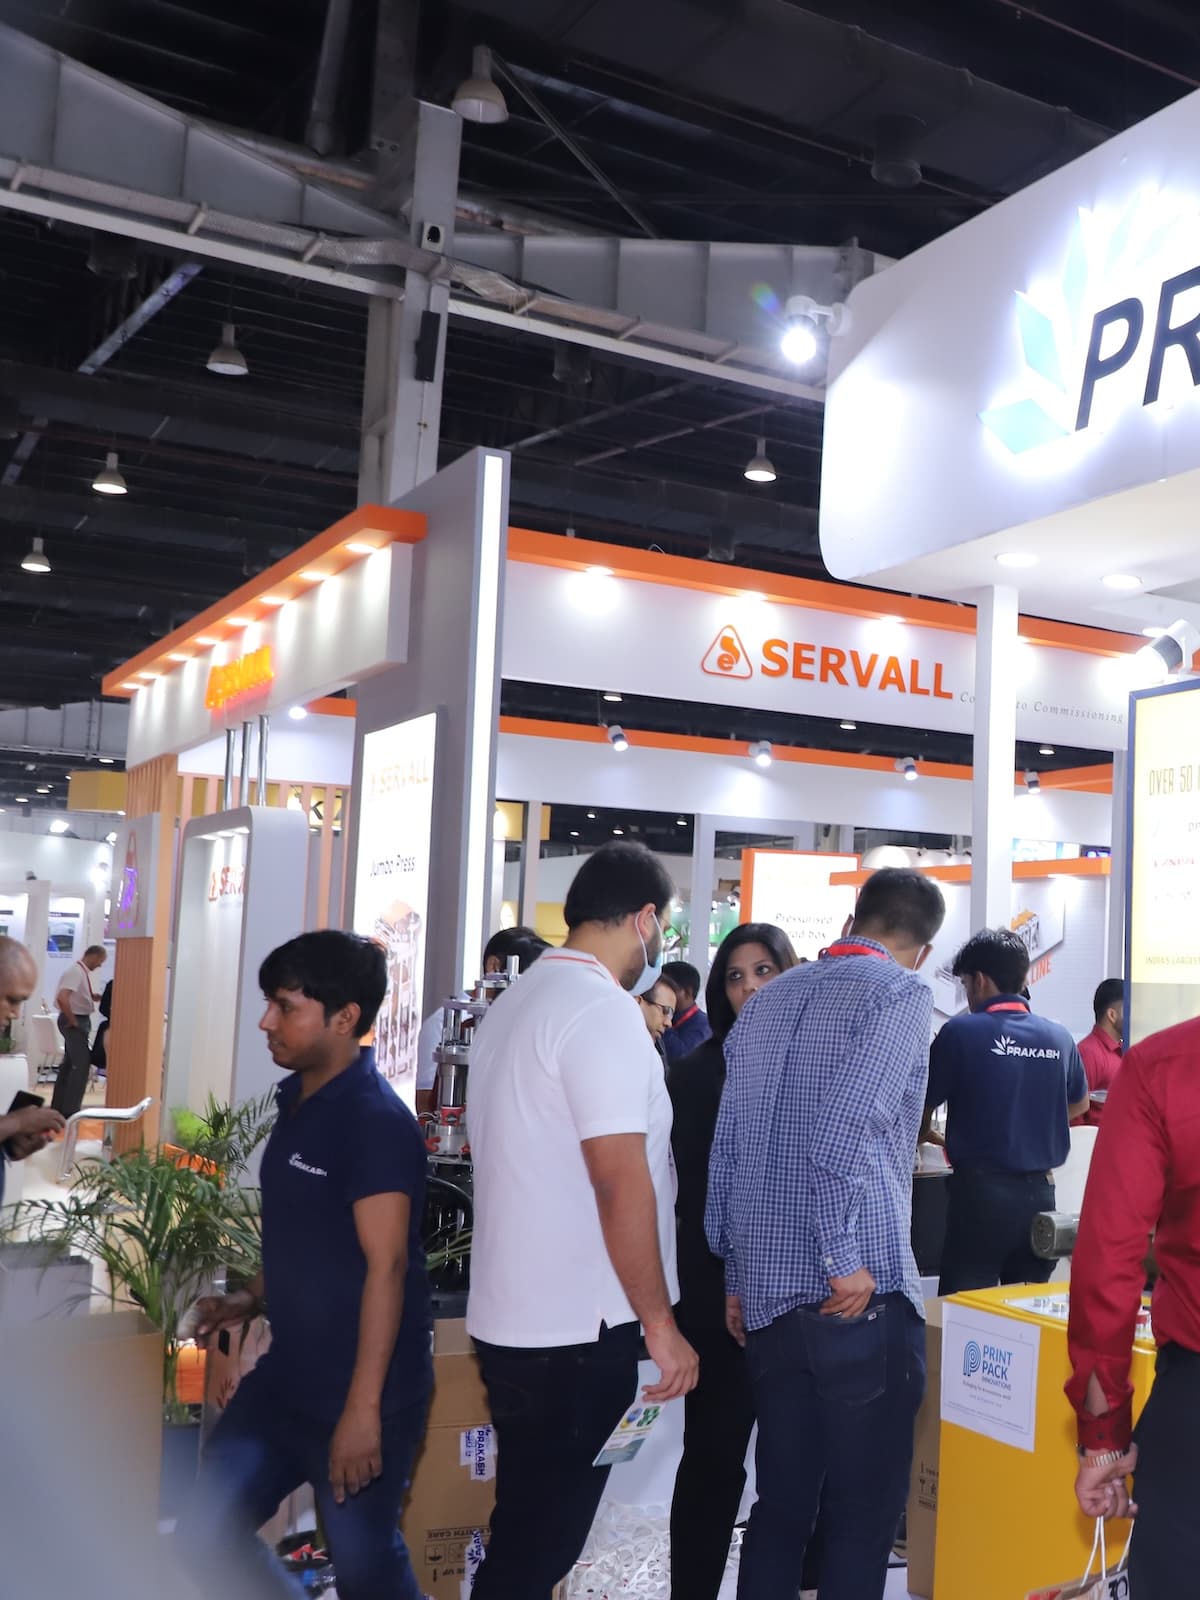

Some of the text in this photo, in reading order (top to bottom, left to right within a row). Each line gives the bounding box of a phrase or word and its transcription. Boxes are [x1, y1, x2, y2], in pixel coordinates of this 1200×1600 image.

[760, 637, 953, 699] SERVALL
[1033, 701, 1124, 724] Commissioning
[1148, 767, 1174, 796] OVER
[1179, 764, 1194, 793] 50
[1006, 1045, 1061, 1060] PRAKASH
[982, 1344, 1013, 1366] PRINT
[982, 1360, 1009, 1381] PACK
[477, 1430, 486, 1477] PRAKASH
